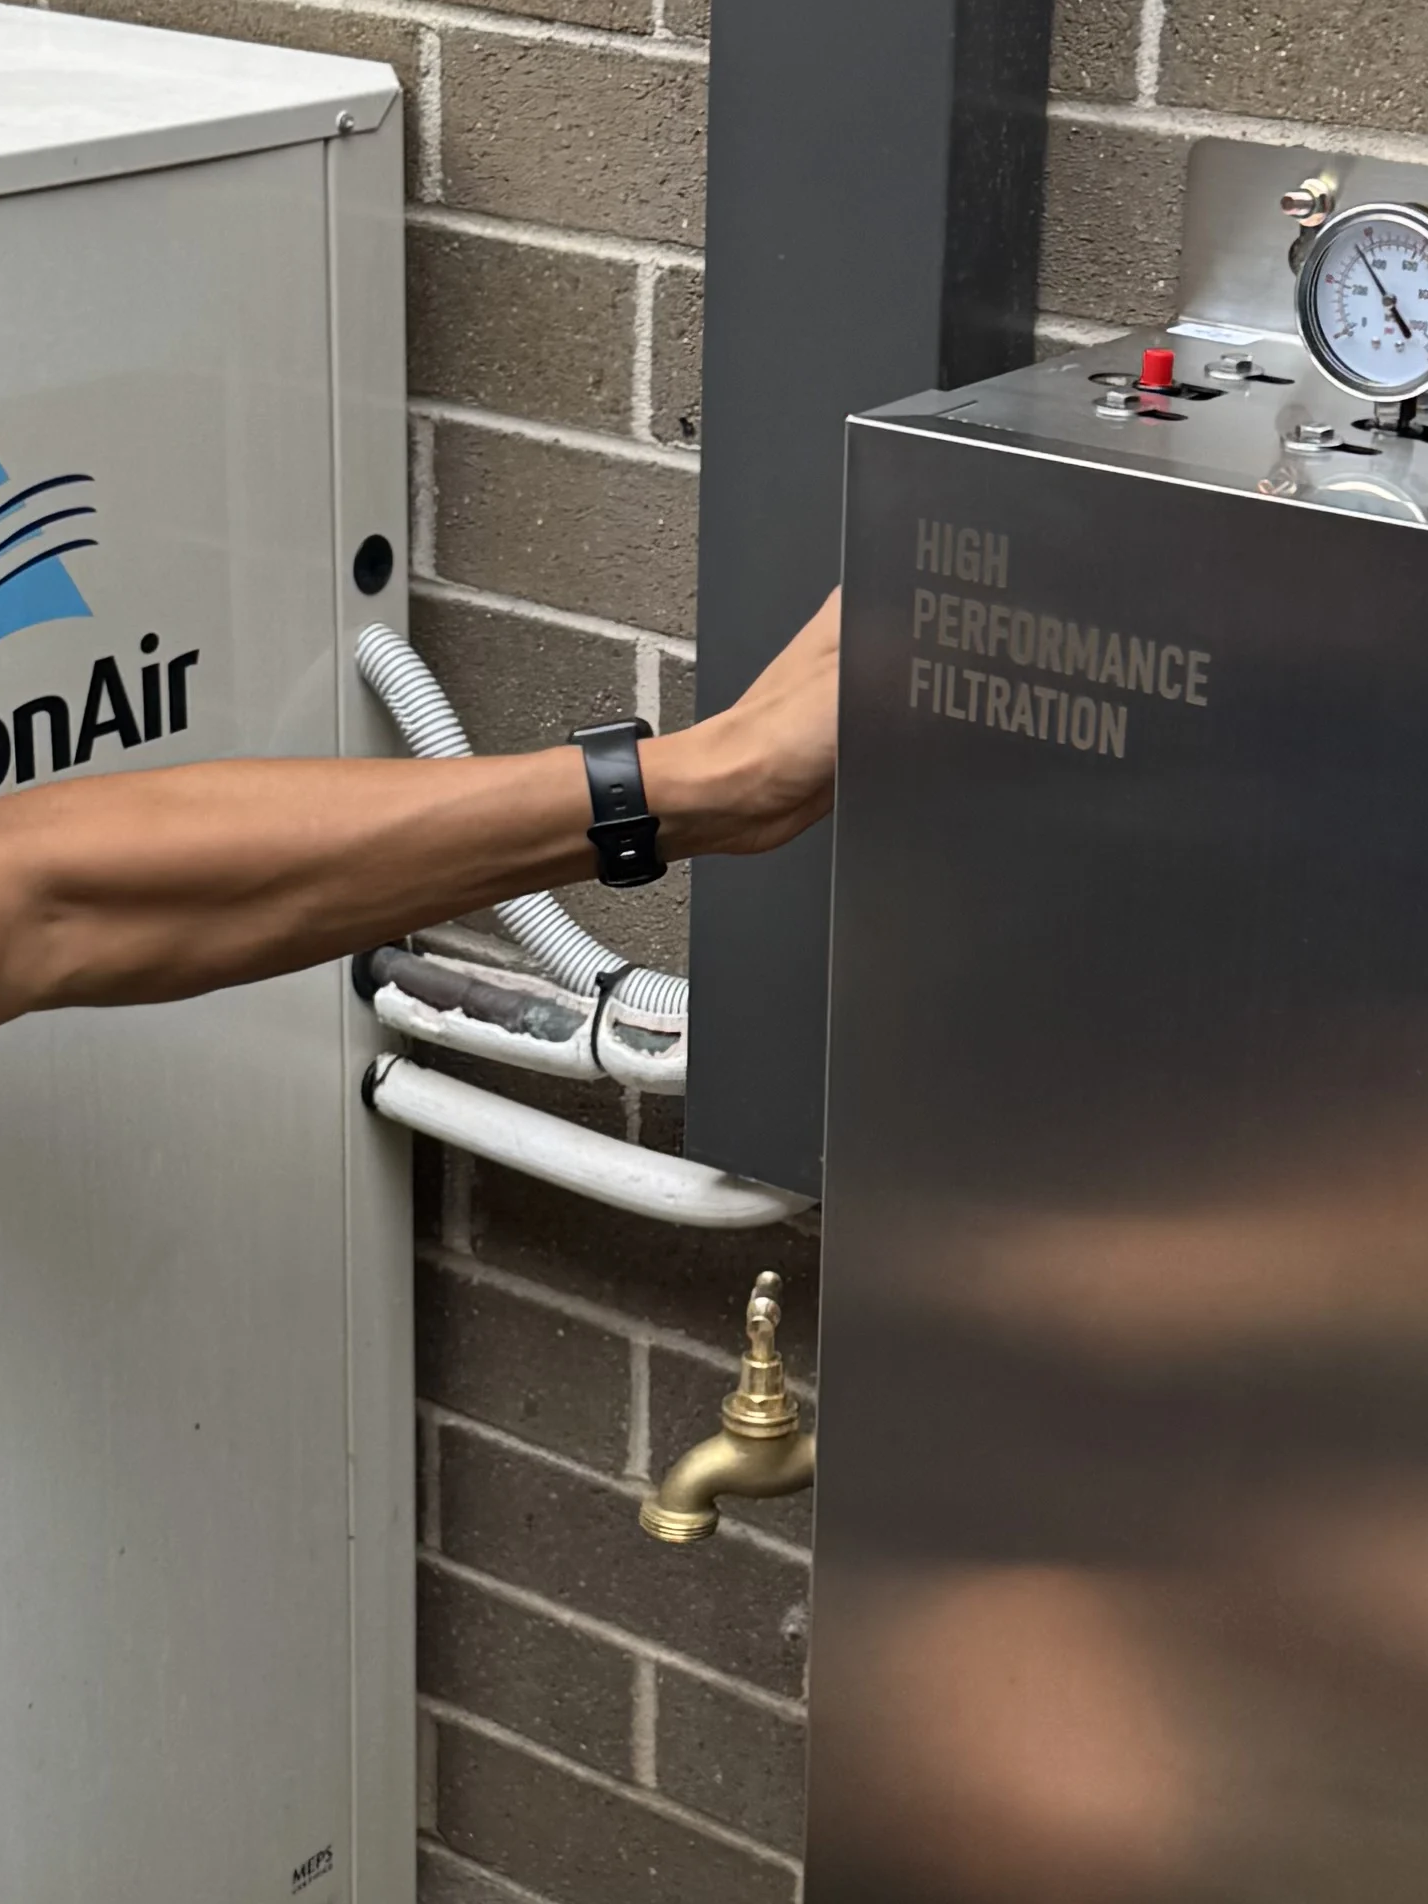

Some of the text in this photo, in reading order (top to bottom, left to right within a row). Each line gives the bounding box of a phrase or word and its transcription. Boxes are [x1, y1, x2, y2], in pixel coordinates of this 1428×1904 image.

[916, 517, 1010, 589] HIGH
[912, 587, 1212, 707] PERFORMANCE
[909, 656, 1128, 759] FILTRATION
